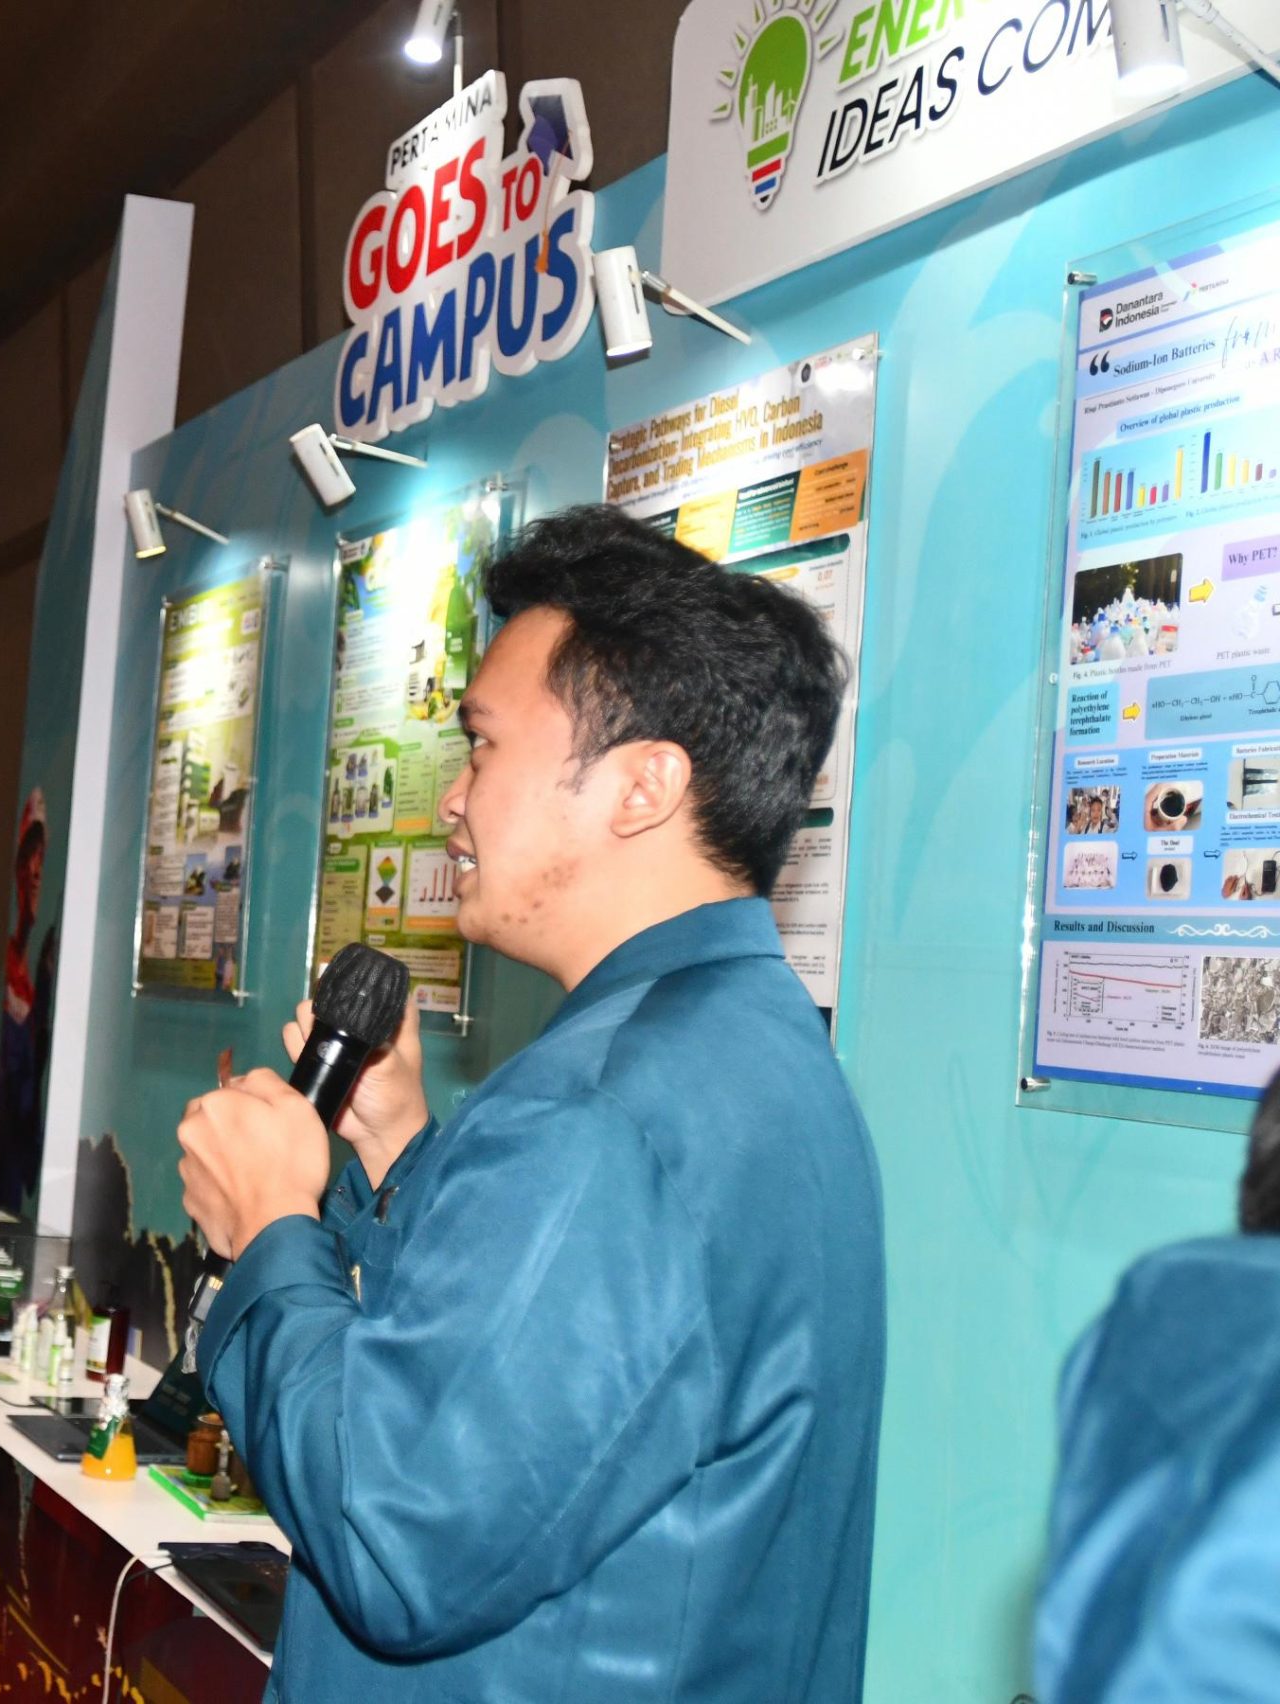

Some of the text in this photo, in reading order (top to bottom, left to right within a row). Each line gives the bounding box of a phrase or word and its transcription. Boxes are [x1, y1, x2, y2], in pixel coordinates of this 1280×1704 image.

[817, 0, 1113, 178] IDEAS COM
[390, 83, 493, 176] PERTAMINA
[349, 136, 542, 310] GOES TO
[340, 207, 578, 428] CAMPUS
[1115, 305, 1160, 327] Indonesia
[1116, 291, 1163, 314] Danantara
[1113, 339, 1216, 377] Sodium-Ion Batteries
[650, 411, 691, 439] Pathways
[694, 402, 707, 422] for
[710, 391, 739, 418] Diesel
[681, 419, 732, 451] Integrating
[763, 395, 801, 424] Carbon
[1120, 396, 1240, 432] Overview of global plastic production
[644, 466, 660, 488] and
[663, 455, 693, 483] Trading
[697, 434, 756, 469] Mechanisms
[759, 429, 769, 449] in
[772, 410, 824, 445] Indonesia
[1228, 552, 1249, 567] Why
[1072, 690, 1108, 703] Reaction of
[1069, 726, 1101, 737] formation
[1054, 919, 1156, 934] Results and Discussion
